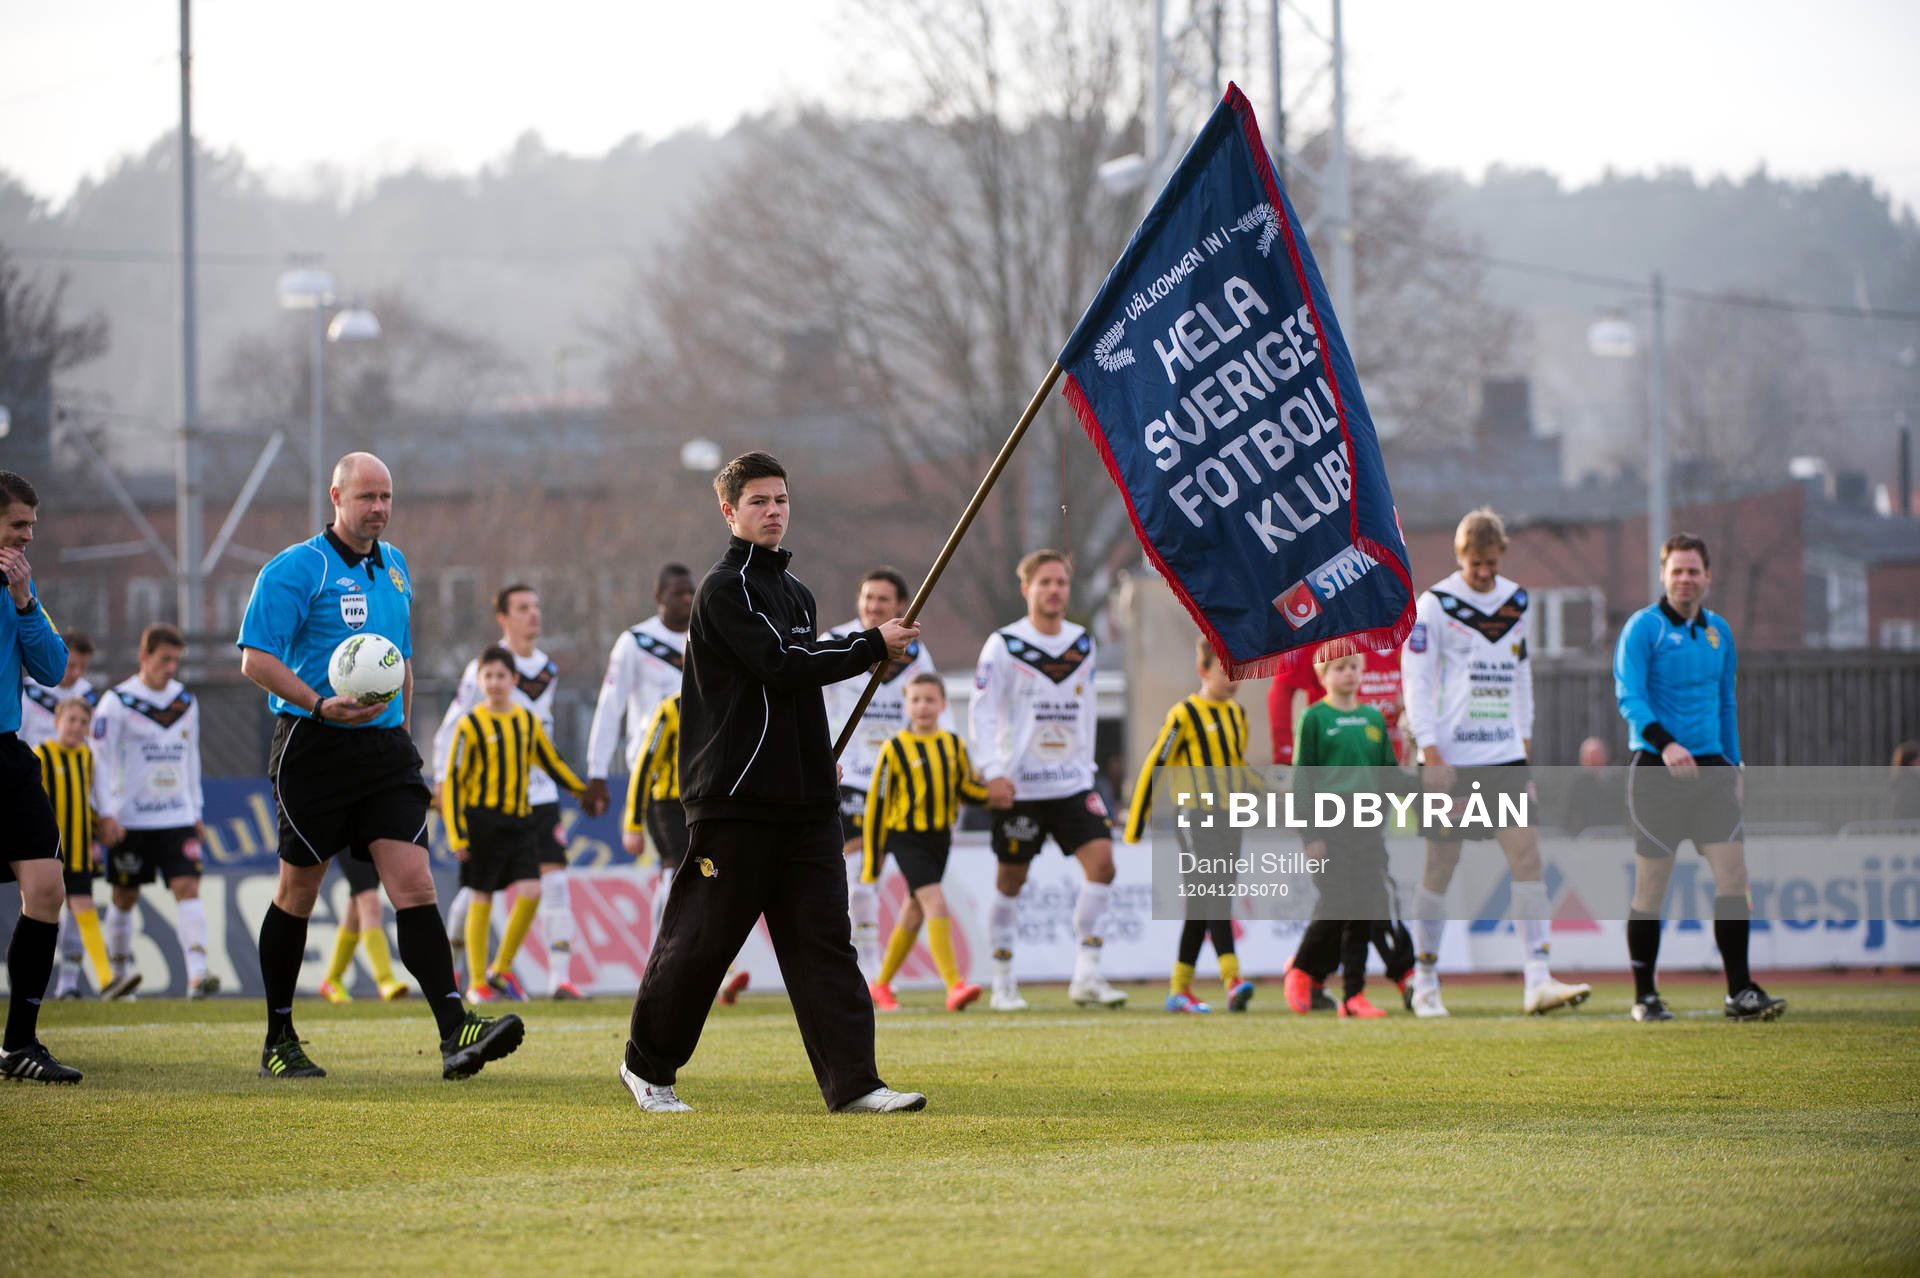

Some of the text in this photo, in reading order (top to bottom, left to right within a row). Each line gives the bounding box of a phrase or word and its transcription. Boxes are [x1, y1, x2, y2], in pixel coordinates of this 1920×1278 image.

[1125, 226, 1232, 321] VÄLKOMMEN IN I
[1153, 275, 1269, 385] HELA
[1144, 304, 1321, 471] SVERIGES
[1244, 440, 1352, 554] KLUB
[345, 607, 365, 616] FIFA
